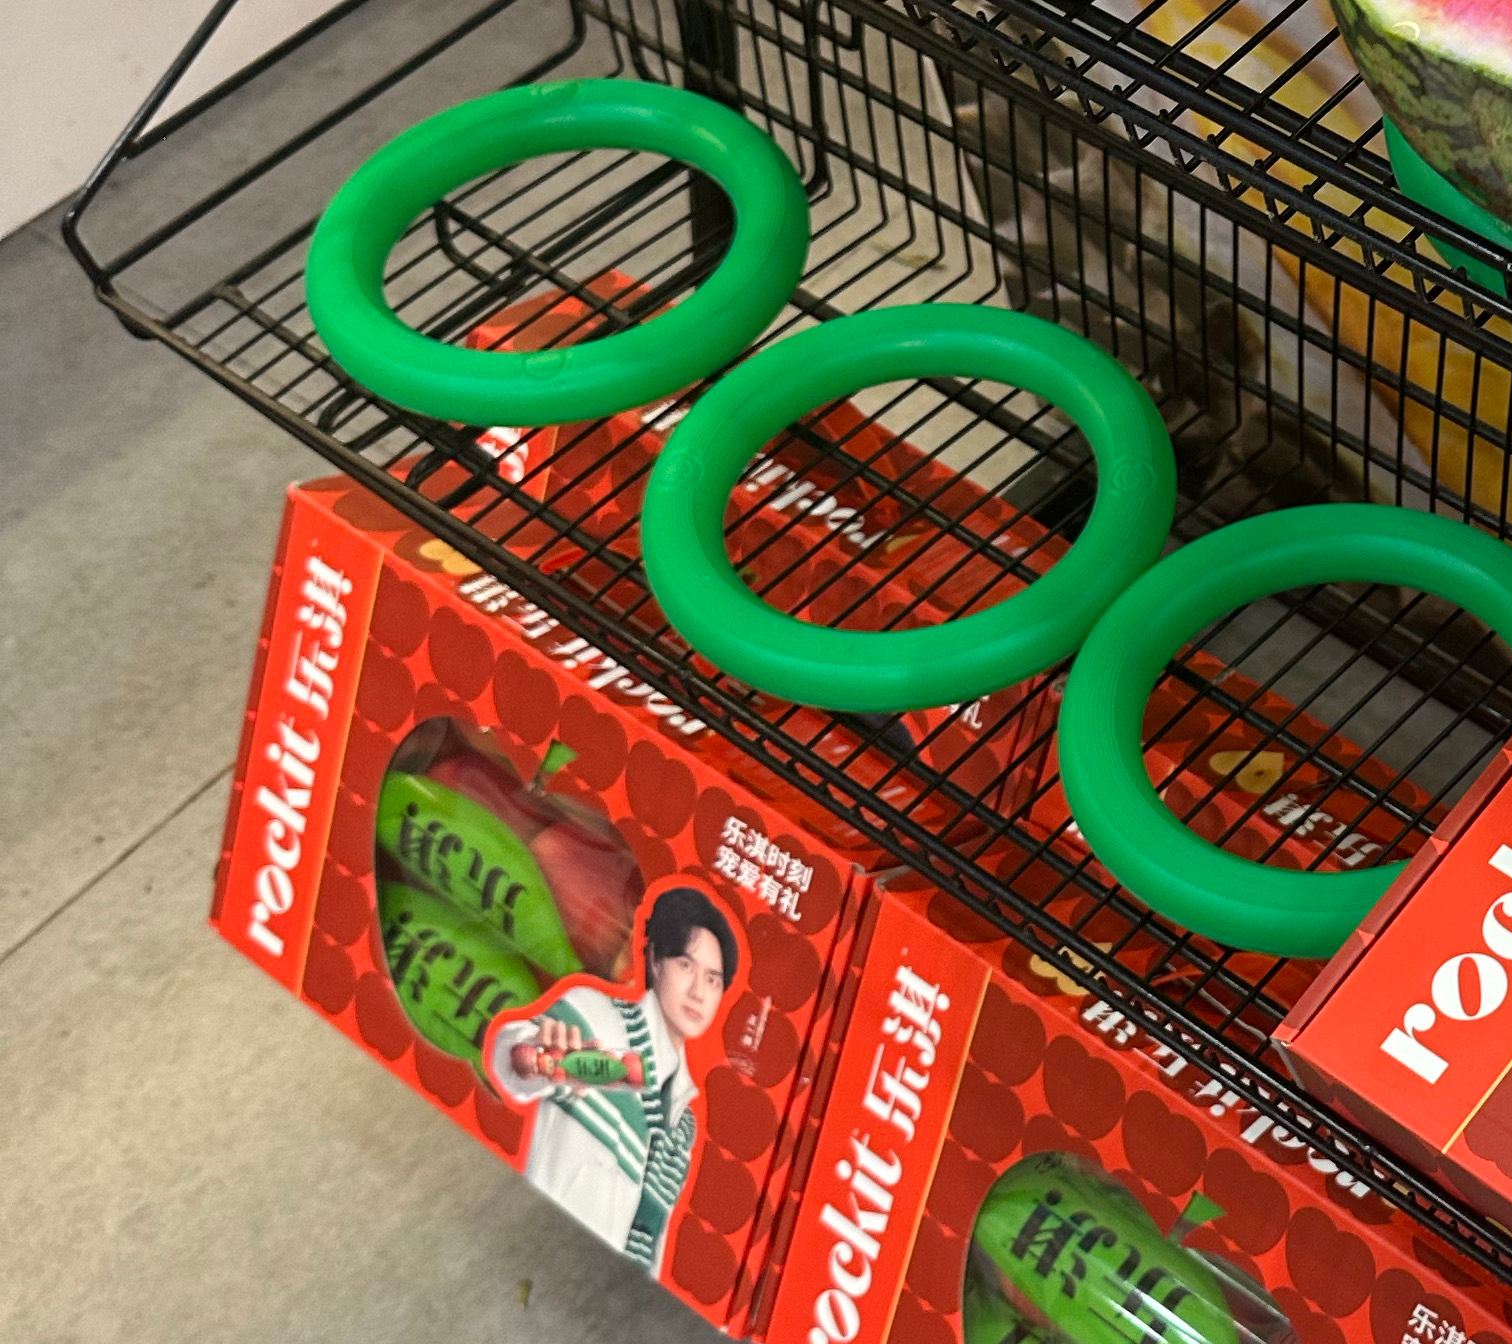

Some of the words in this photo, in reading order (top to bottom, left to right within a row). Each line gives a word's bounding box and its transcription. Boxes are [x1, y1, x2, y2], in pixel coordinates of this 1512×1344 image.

[285, 556, 353, 719] 乐淇
[244, 718, 322, 957] rockit
[713, 845, 804, 922] 宠爱有礼
[720, 816, 814, 895] 乐淇时刻
[861, 965, 950, 1142] 乐淇
